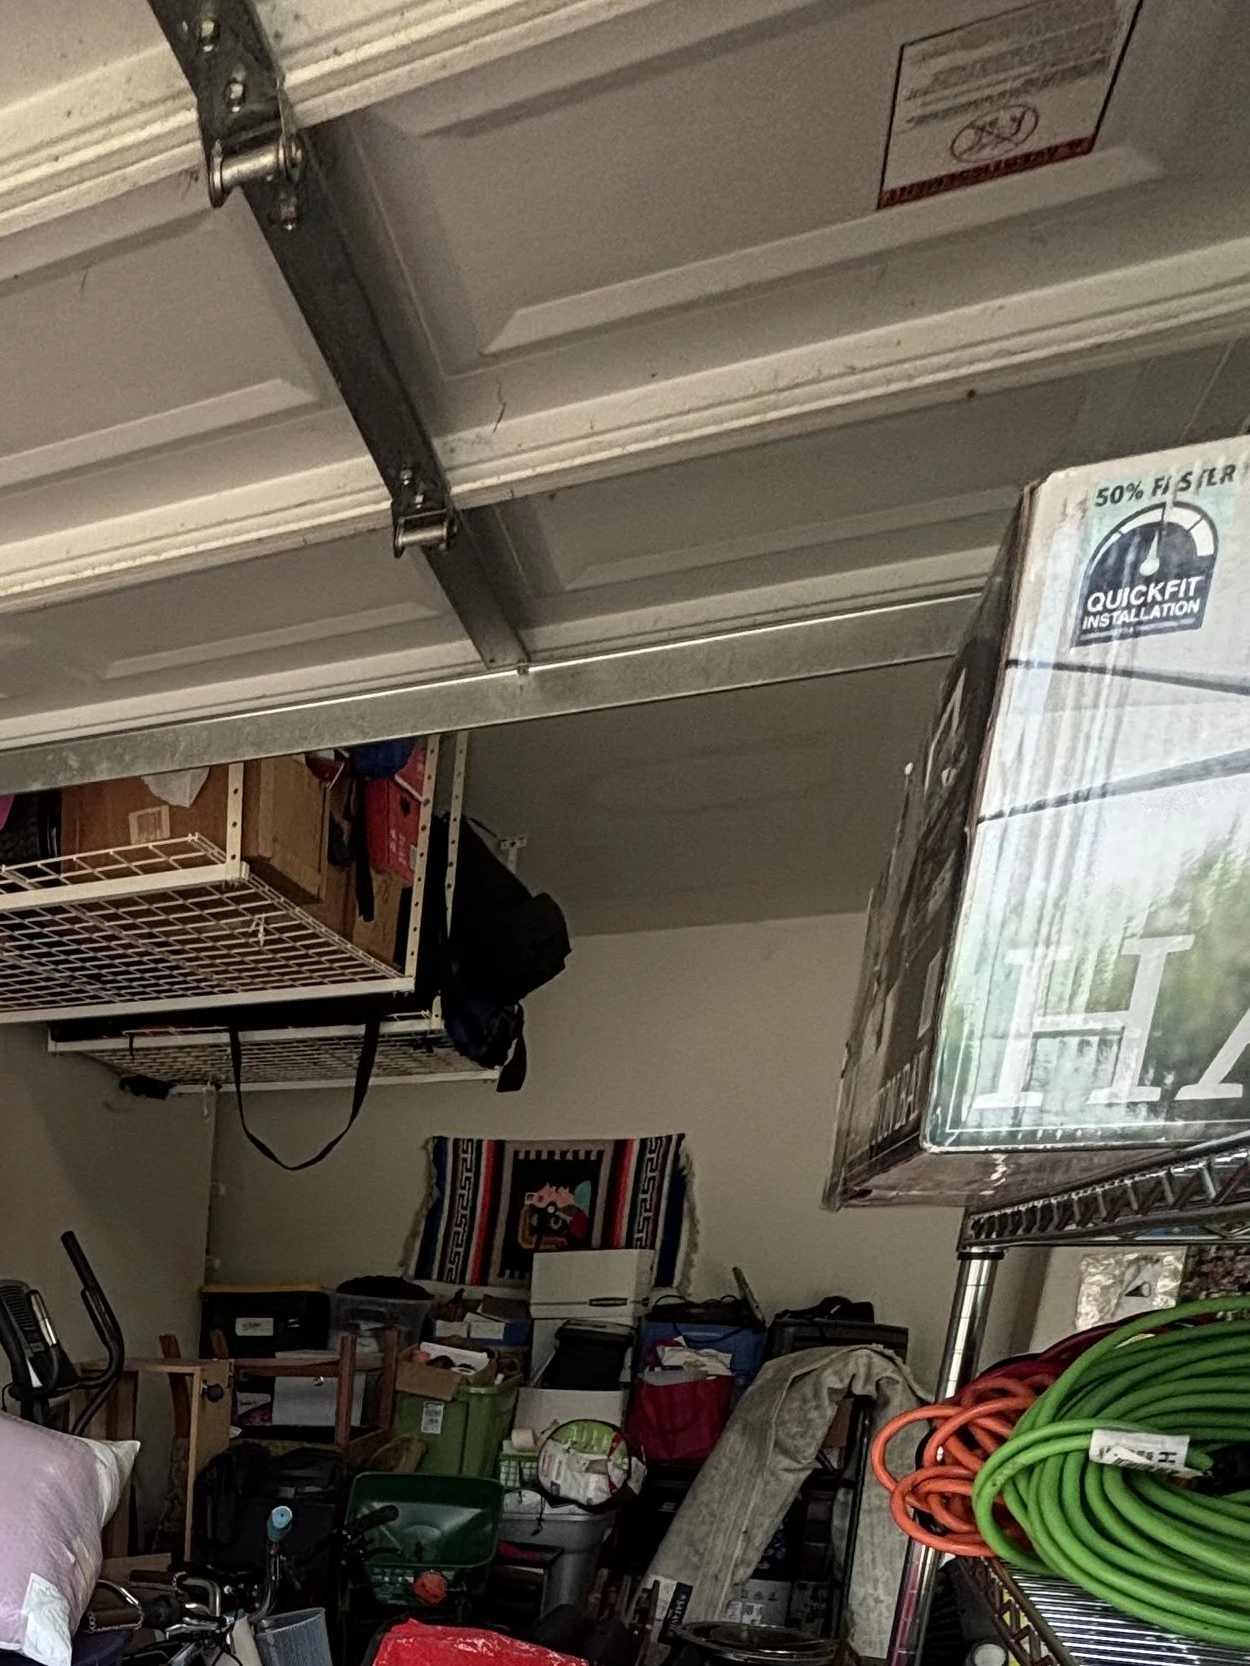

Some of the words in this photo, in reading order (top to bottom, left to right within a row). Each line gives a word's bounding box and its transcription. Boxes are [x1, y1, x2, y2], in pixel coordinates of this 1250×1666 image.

[1094, 480, 1144, 508] 50%
[1086, 575, 1206, 613] QUICKFIT
[1081, 598, 1201, 631] INSTALLATION
